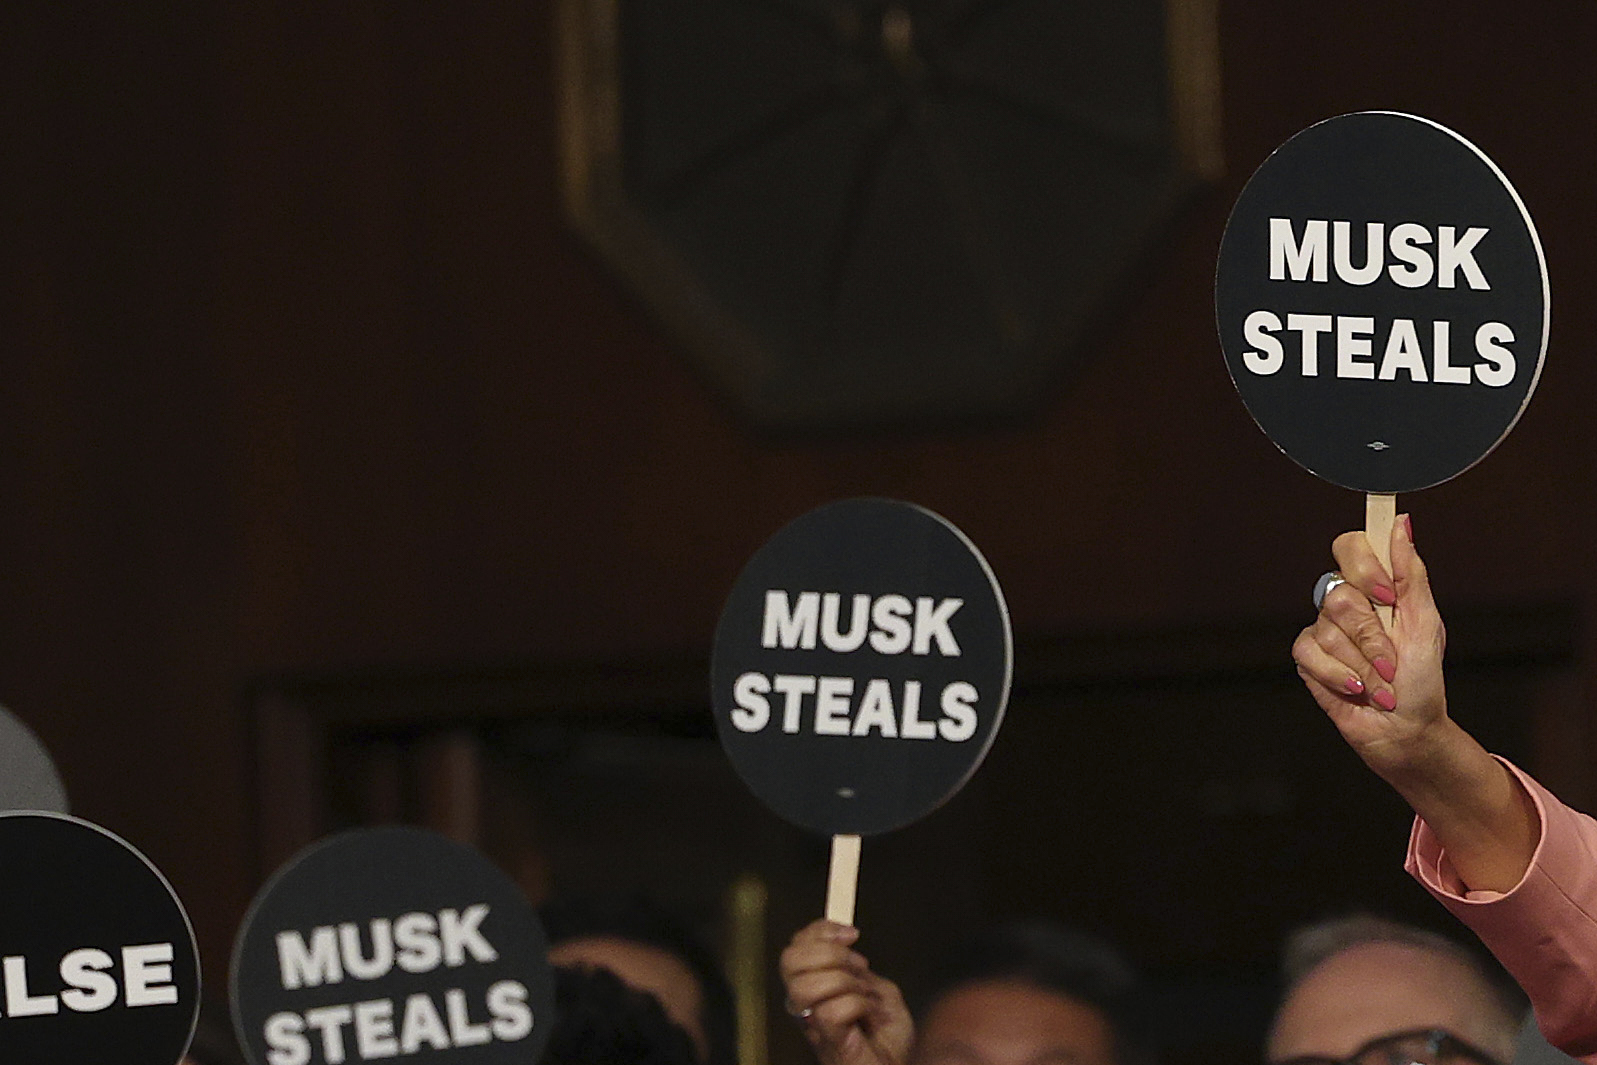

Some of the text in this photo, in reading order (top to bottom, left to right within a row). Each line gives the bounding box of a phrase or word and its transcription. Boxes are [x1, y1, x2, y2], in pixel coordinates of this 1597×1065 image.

[1269, 218, 1491, 291] MUSK
[1242, 310, 1516, 387] STEALS
[762, 590, 963, 656] MUSK
[731, 672, 979, 742] STEALS
[277, 904, 497, 990] MUSK
